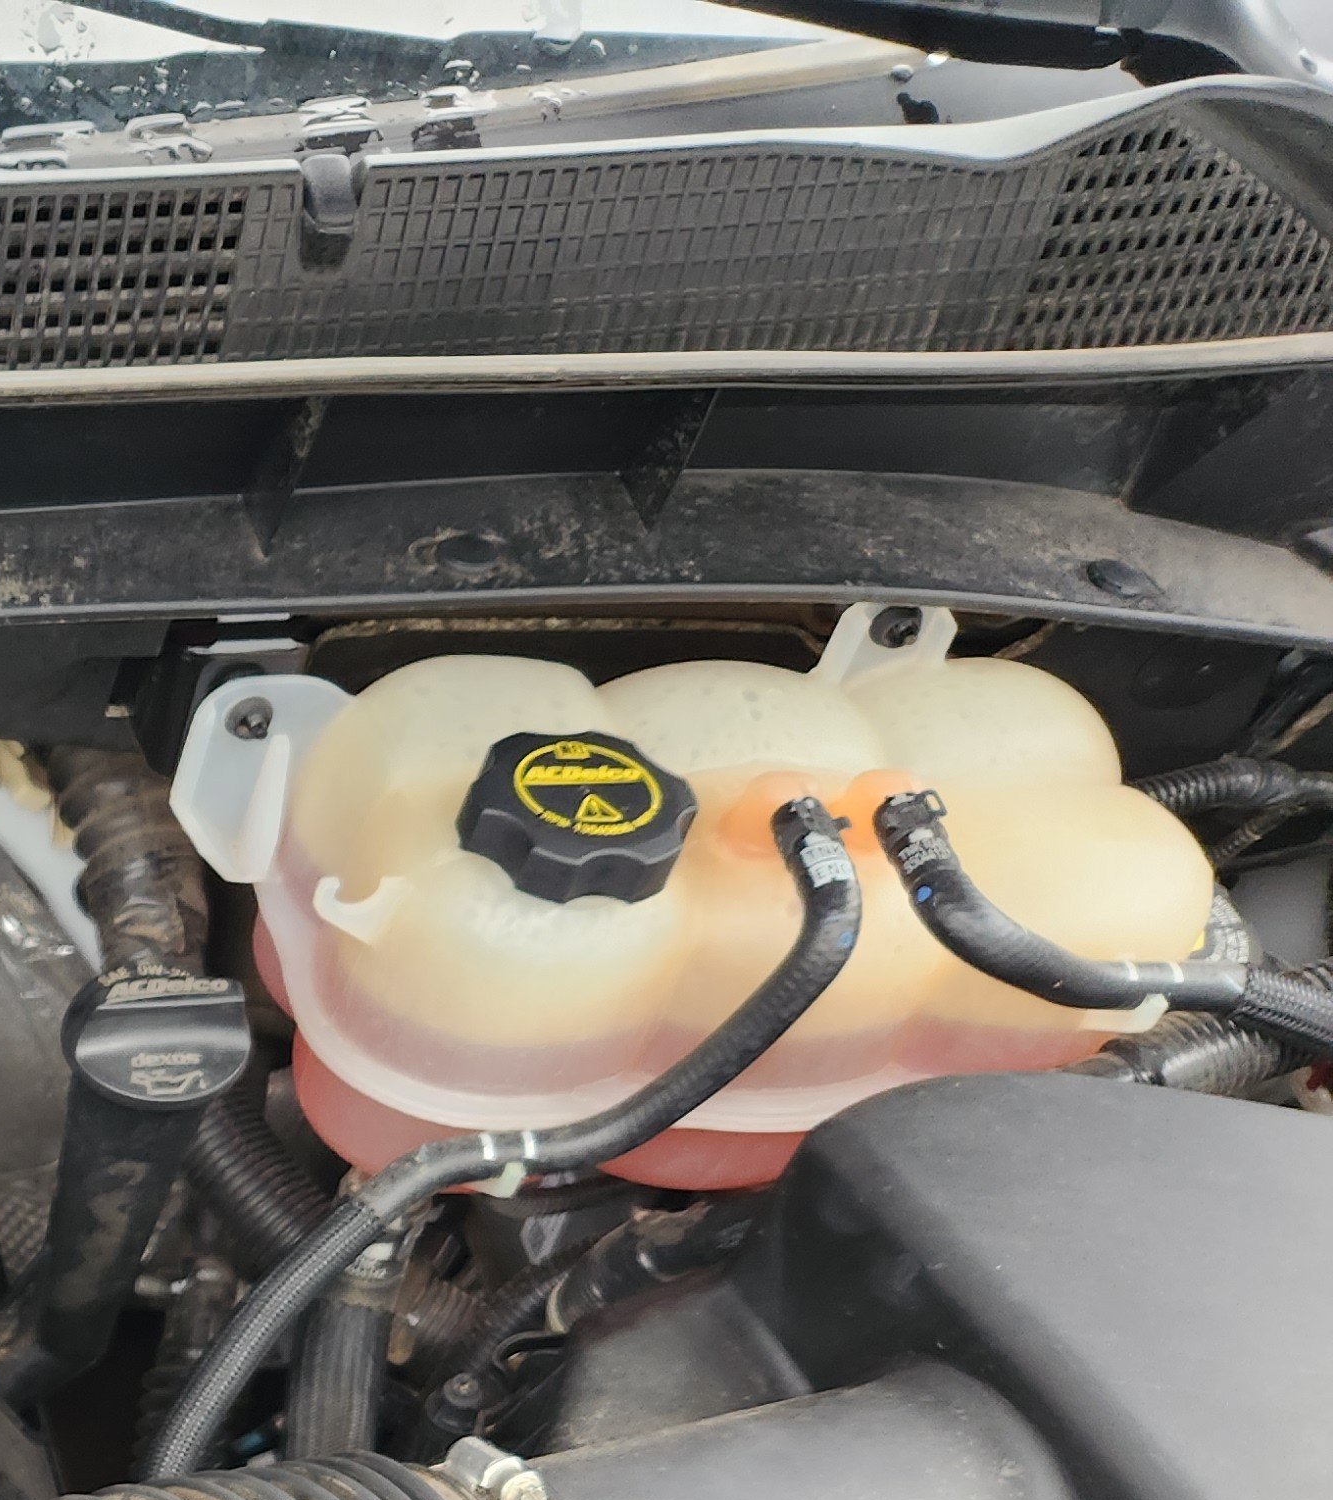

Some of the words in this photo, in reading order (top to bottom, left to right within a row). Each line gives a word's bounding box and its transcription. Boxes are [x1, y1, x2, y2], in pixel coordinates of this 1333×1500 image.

[523, 765, 644, 784] ACDelco
[98, 965, 130, 987] SAE
[106, 978, 229, 1001] ACDelco
[131, 1052, 203, 1068] dexos
